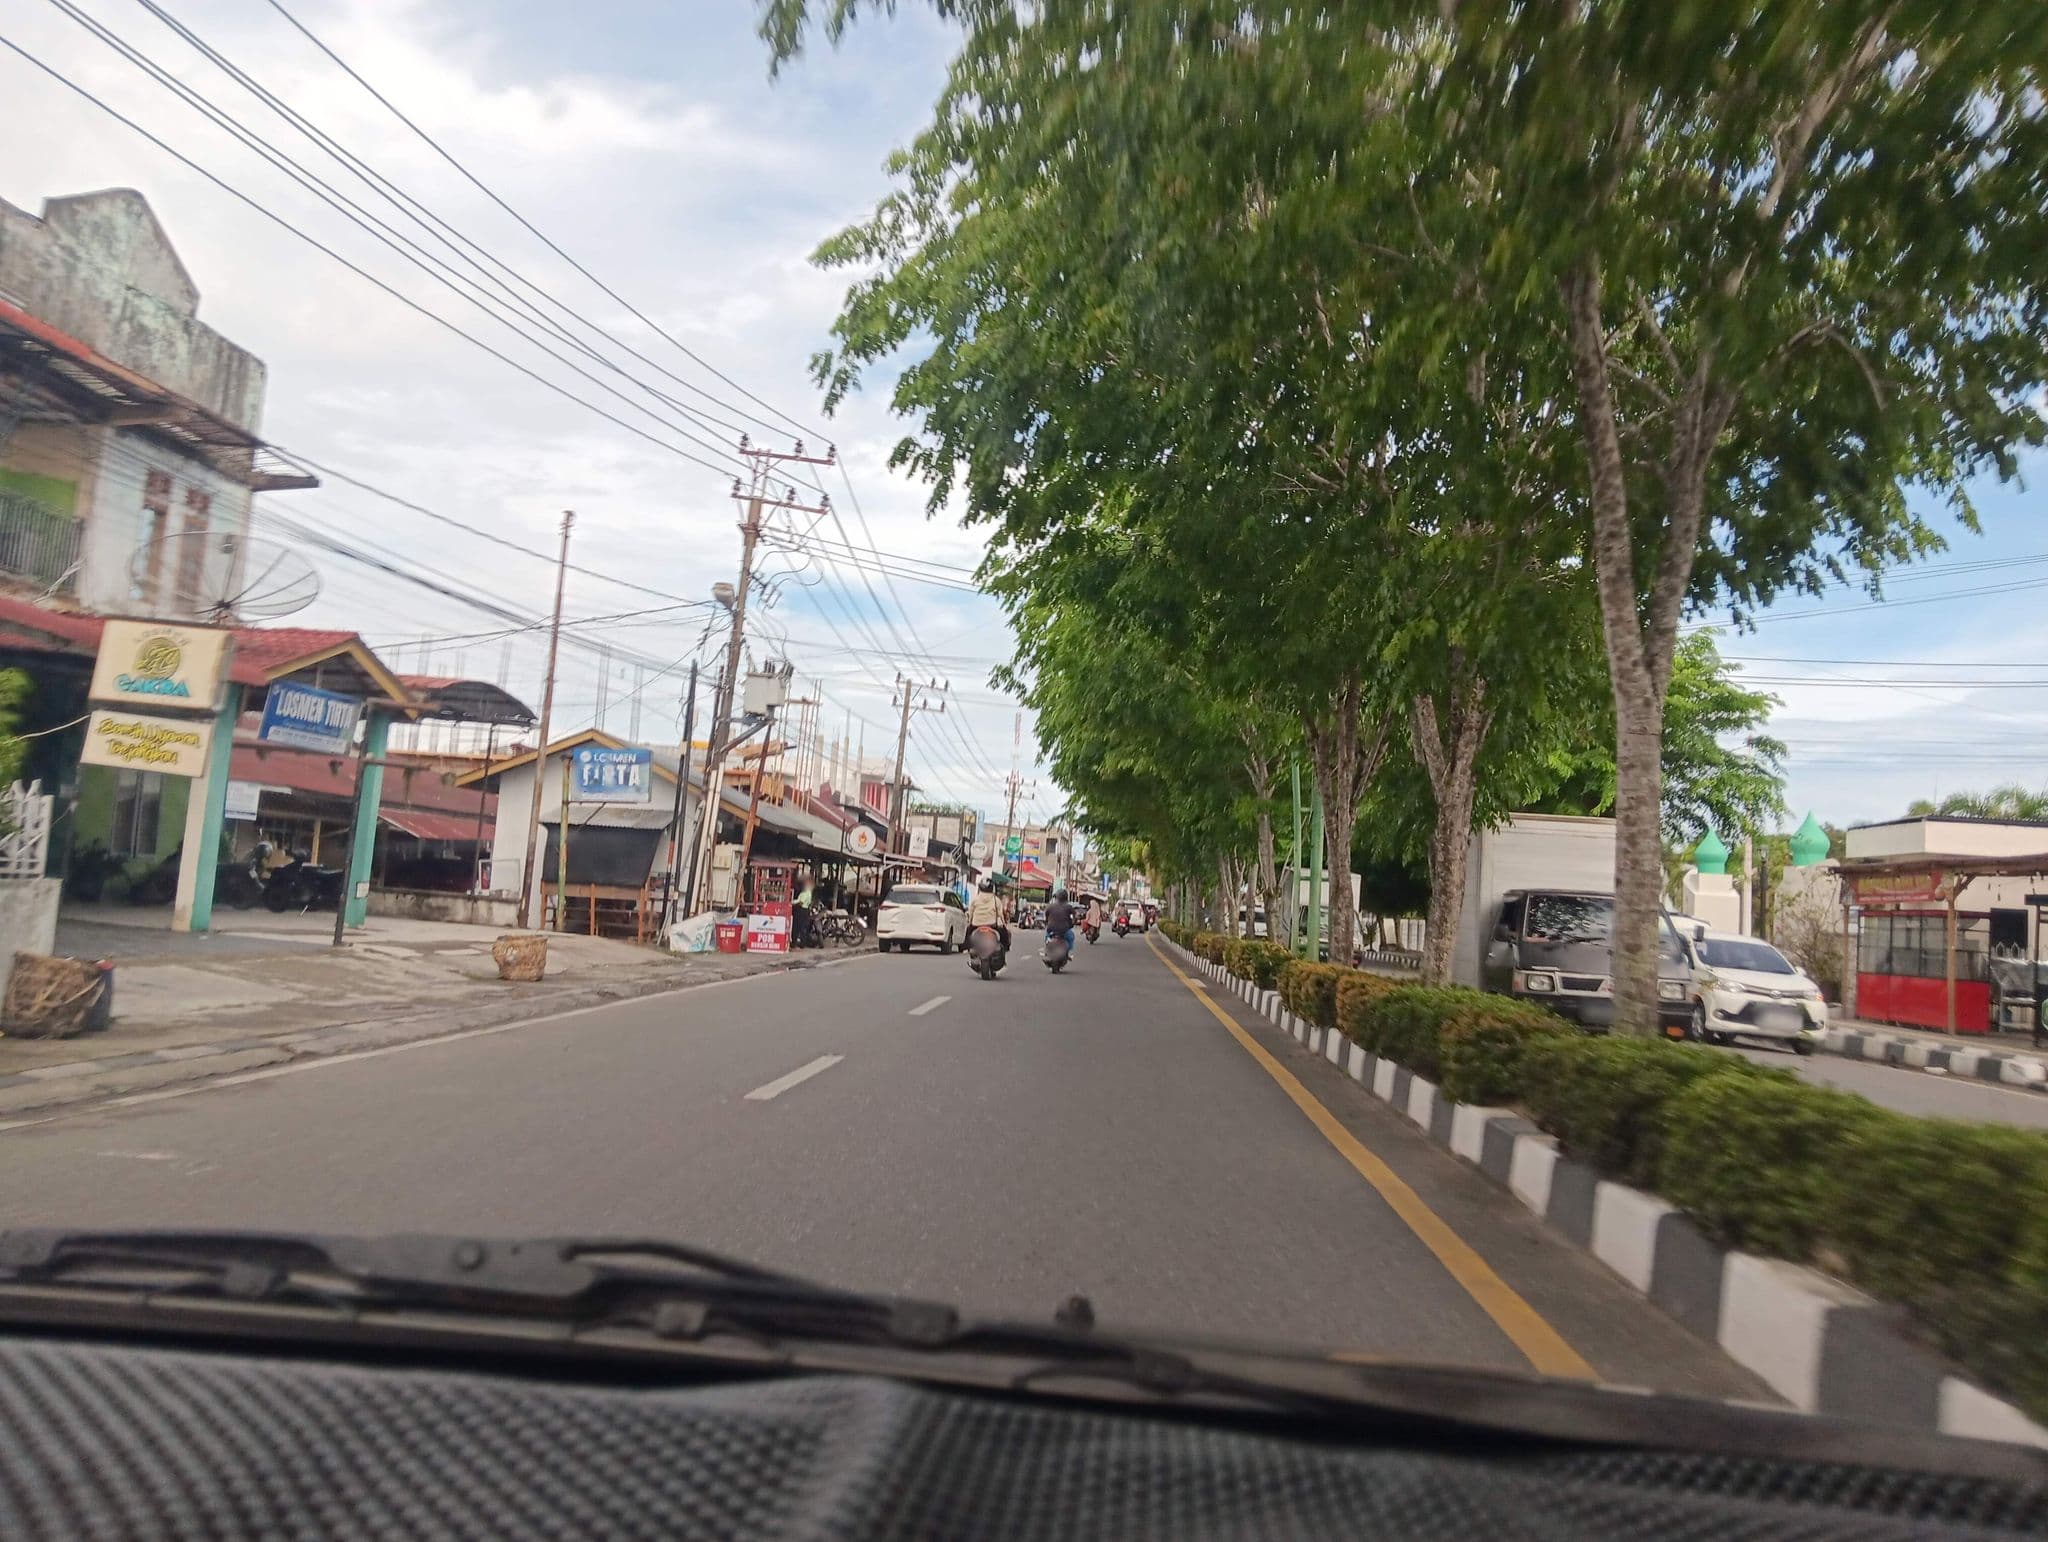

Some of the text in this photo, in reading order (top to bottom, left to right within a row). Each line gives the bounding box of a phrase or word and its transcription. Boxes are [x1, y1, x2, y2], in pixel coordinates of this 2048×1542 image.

[276, 690, 356, 732] LOSMEN TIRTA
[757, 933, 775, 943] POM
